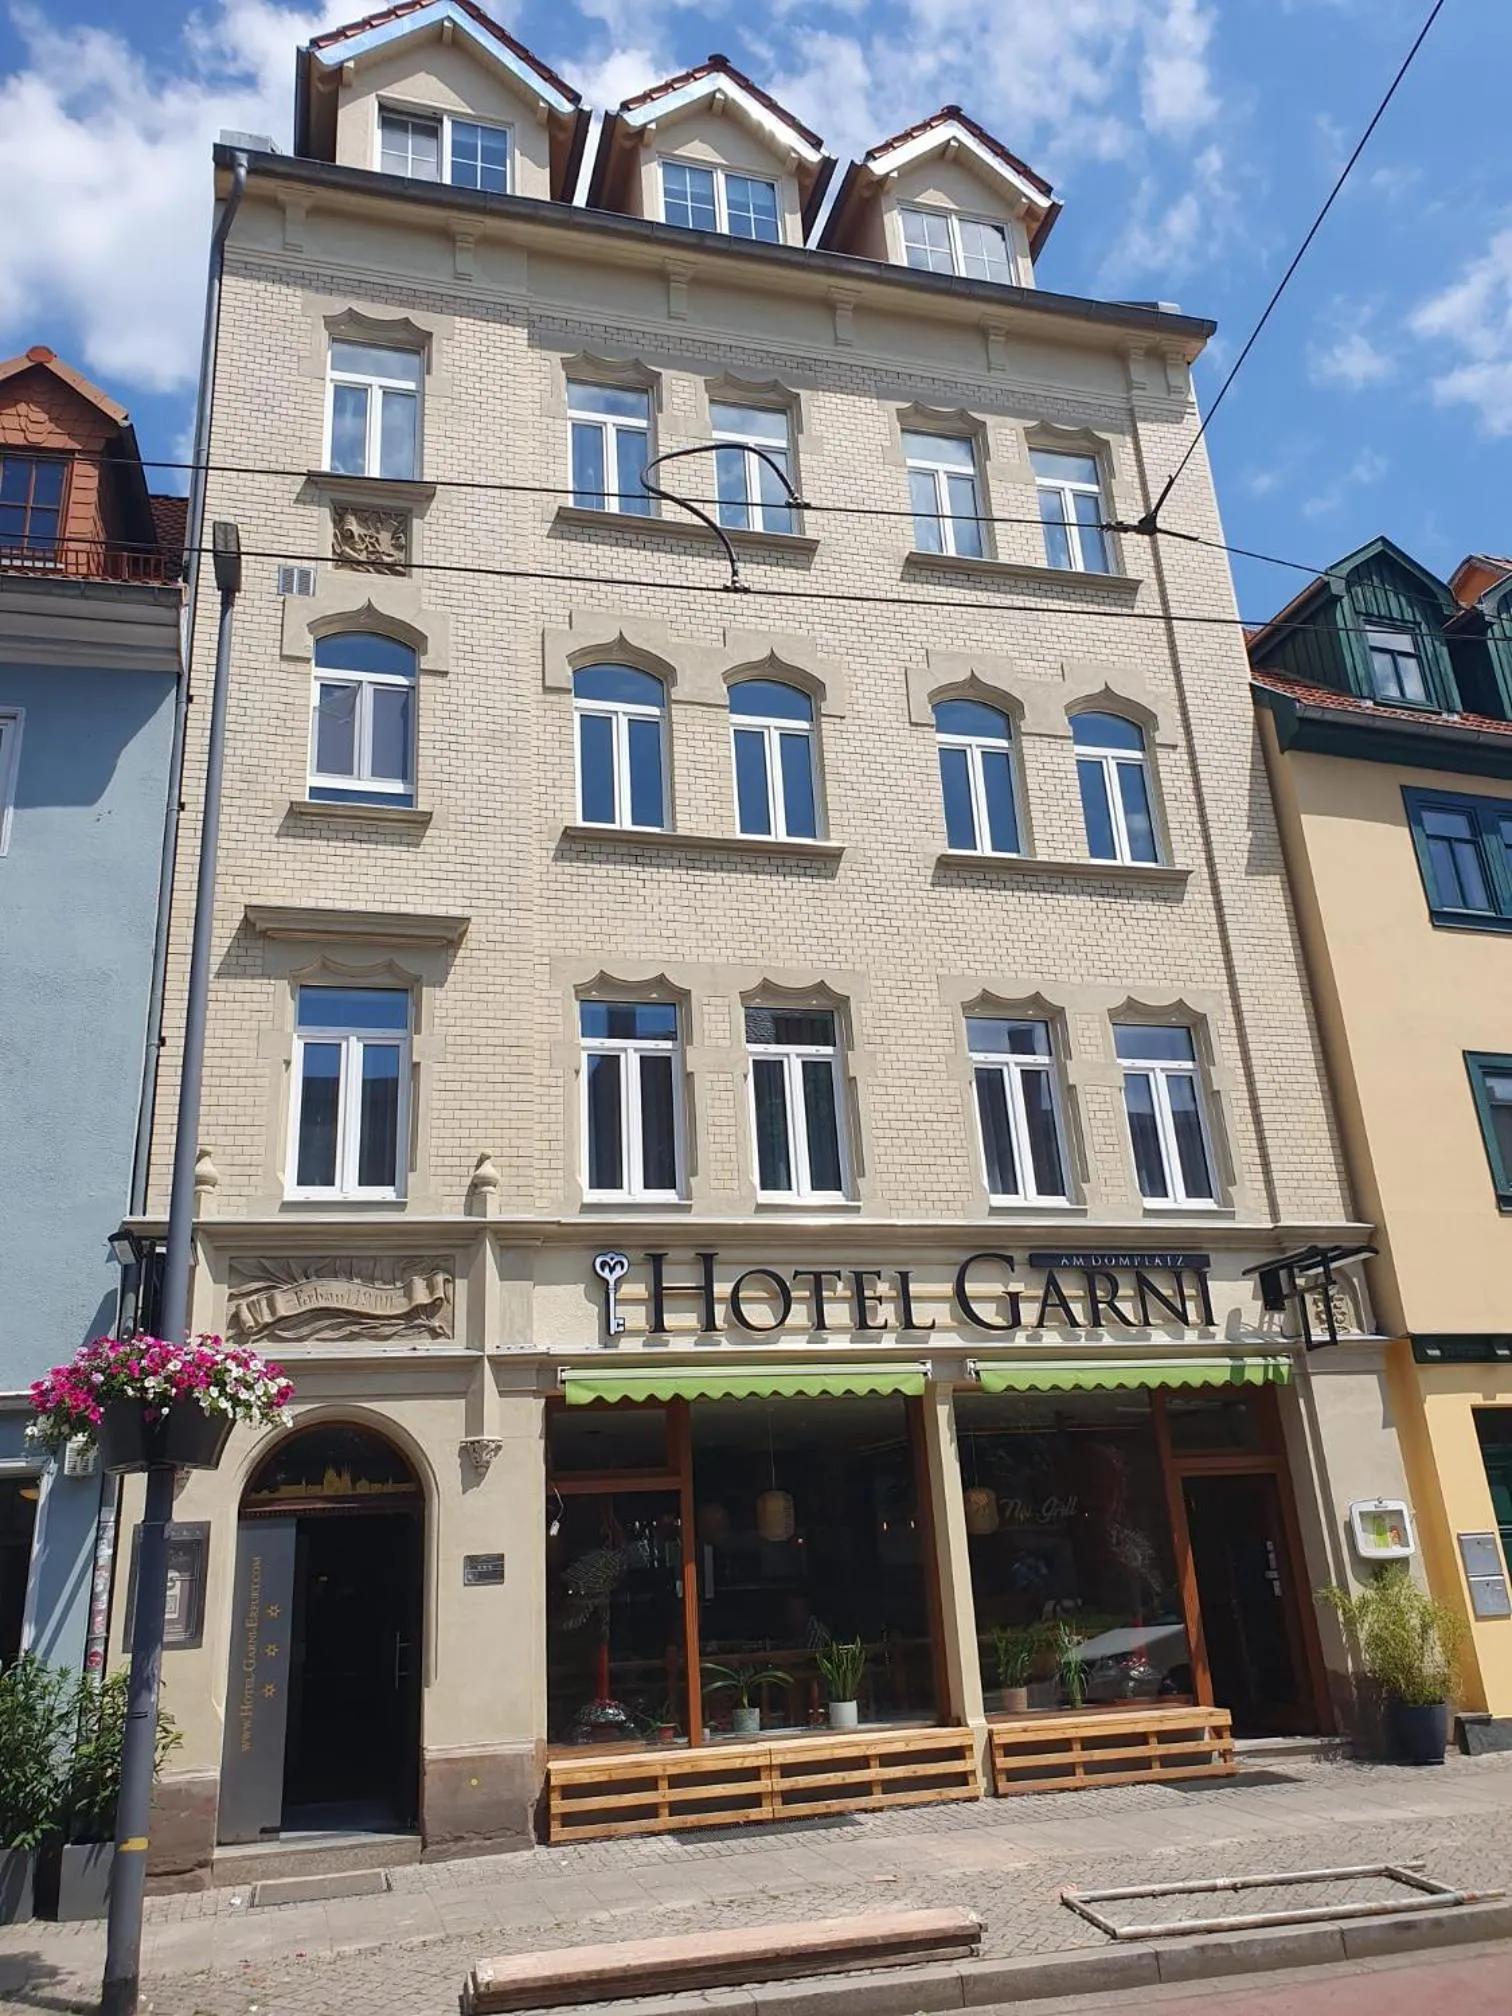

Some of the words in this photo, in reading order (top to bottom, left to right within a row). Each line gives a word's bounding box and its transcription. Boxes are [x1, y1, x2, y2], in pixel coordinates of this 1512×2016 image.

[1061, 1255, 1084, 1267] AM
[1092, 1255, 1185, 1267] DOMPLATZ
[645, 1252, 936, 1333] HOTEL
[955, 1252, 1219, 1331] GARNI
